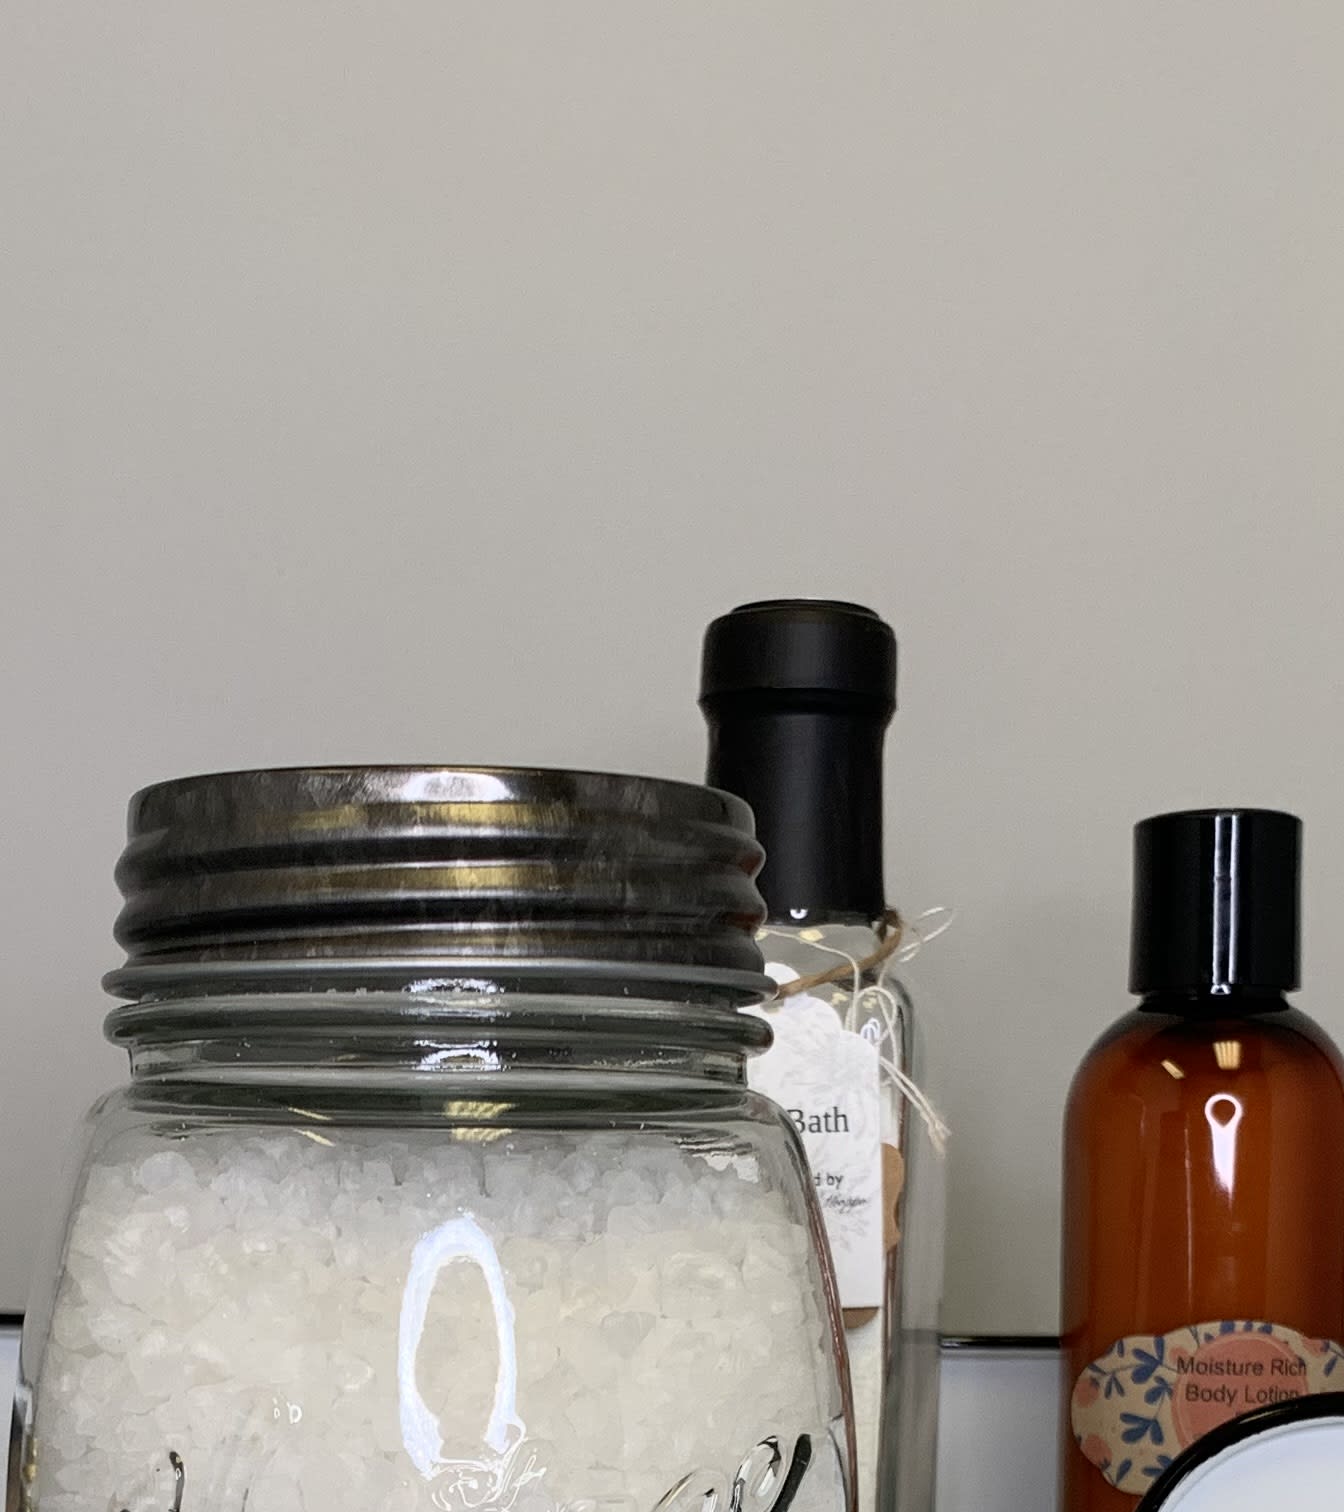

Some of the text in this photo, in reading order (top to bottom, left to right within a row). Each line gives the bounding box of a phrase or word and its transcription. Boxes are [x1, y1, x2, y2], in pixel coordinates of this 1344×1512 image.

[785, 1106, 850, 1134] Bath
[826, 1173, 843, 1191] by
[1176, 1356, 1308, 1377] Moisture Rich
[1185, 1384, 1238, 1409] Body
